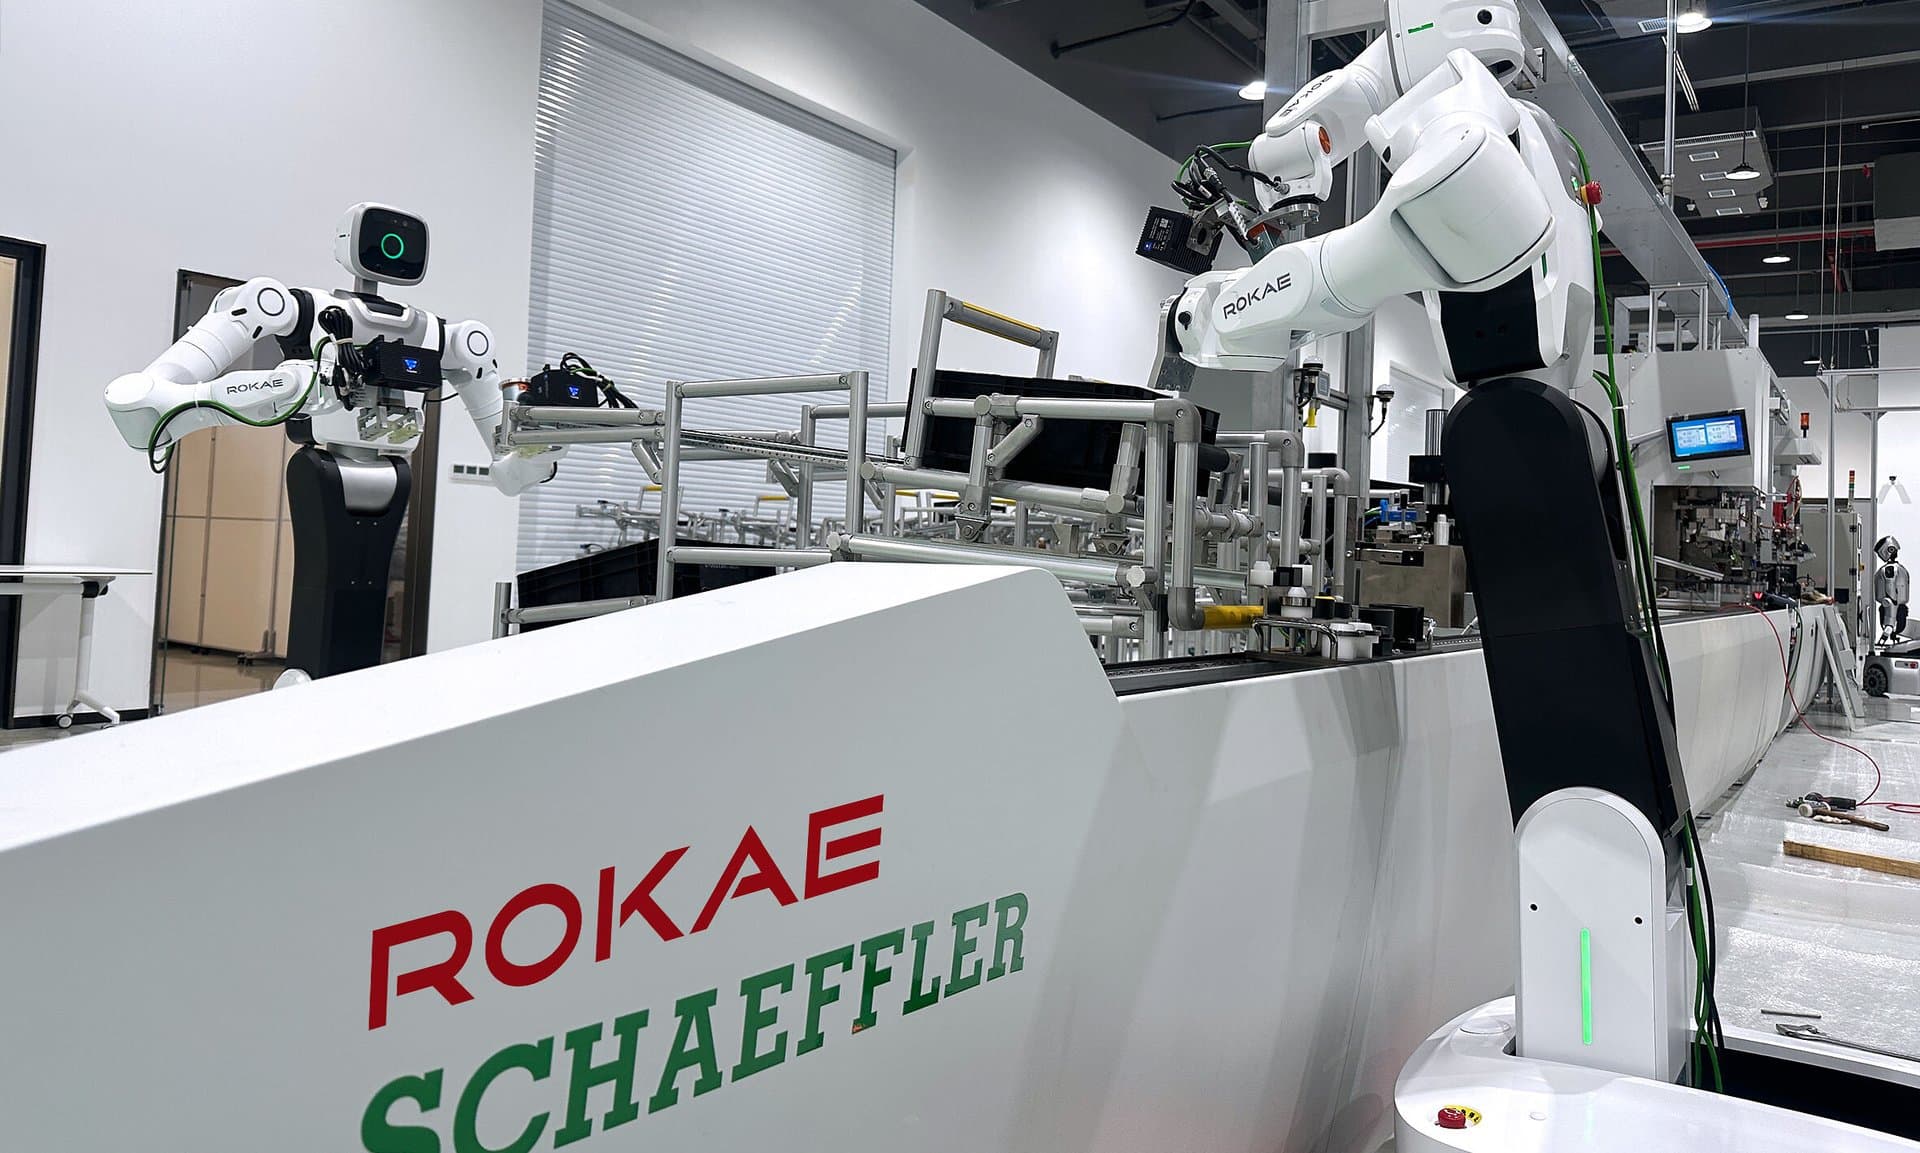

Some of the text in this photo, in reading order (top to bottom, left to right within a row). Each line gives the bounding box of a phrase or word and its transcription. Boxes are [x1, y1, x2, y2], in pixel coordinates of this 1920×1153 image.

[1223, 272, 1292, 319] ROKAE
[226, 378, 284, 394] ROKAE
[368, 794, 885, 1031] ROKAE
[361, 892, 1029, 1153] SCHAEFFLER
